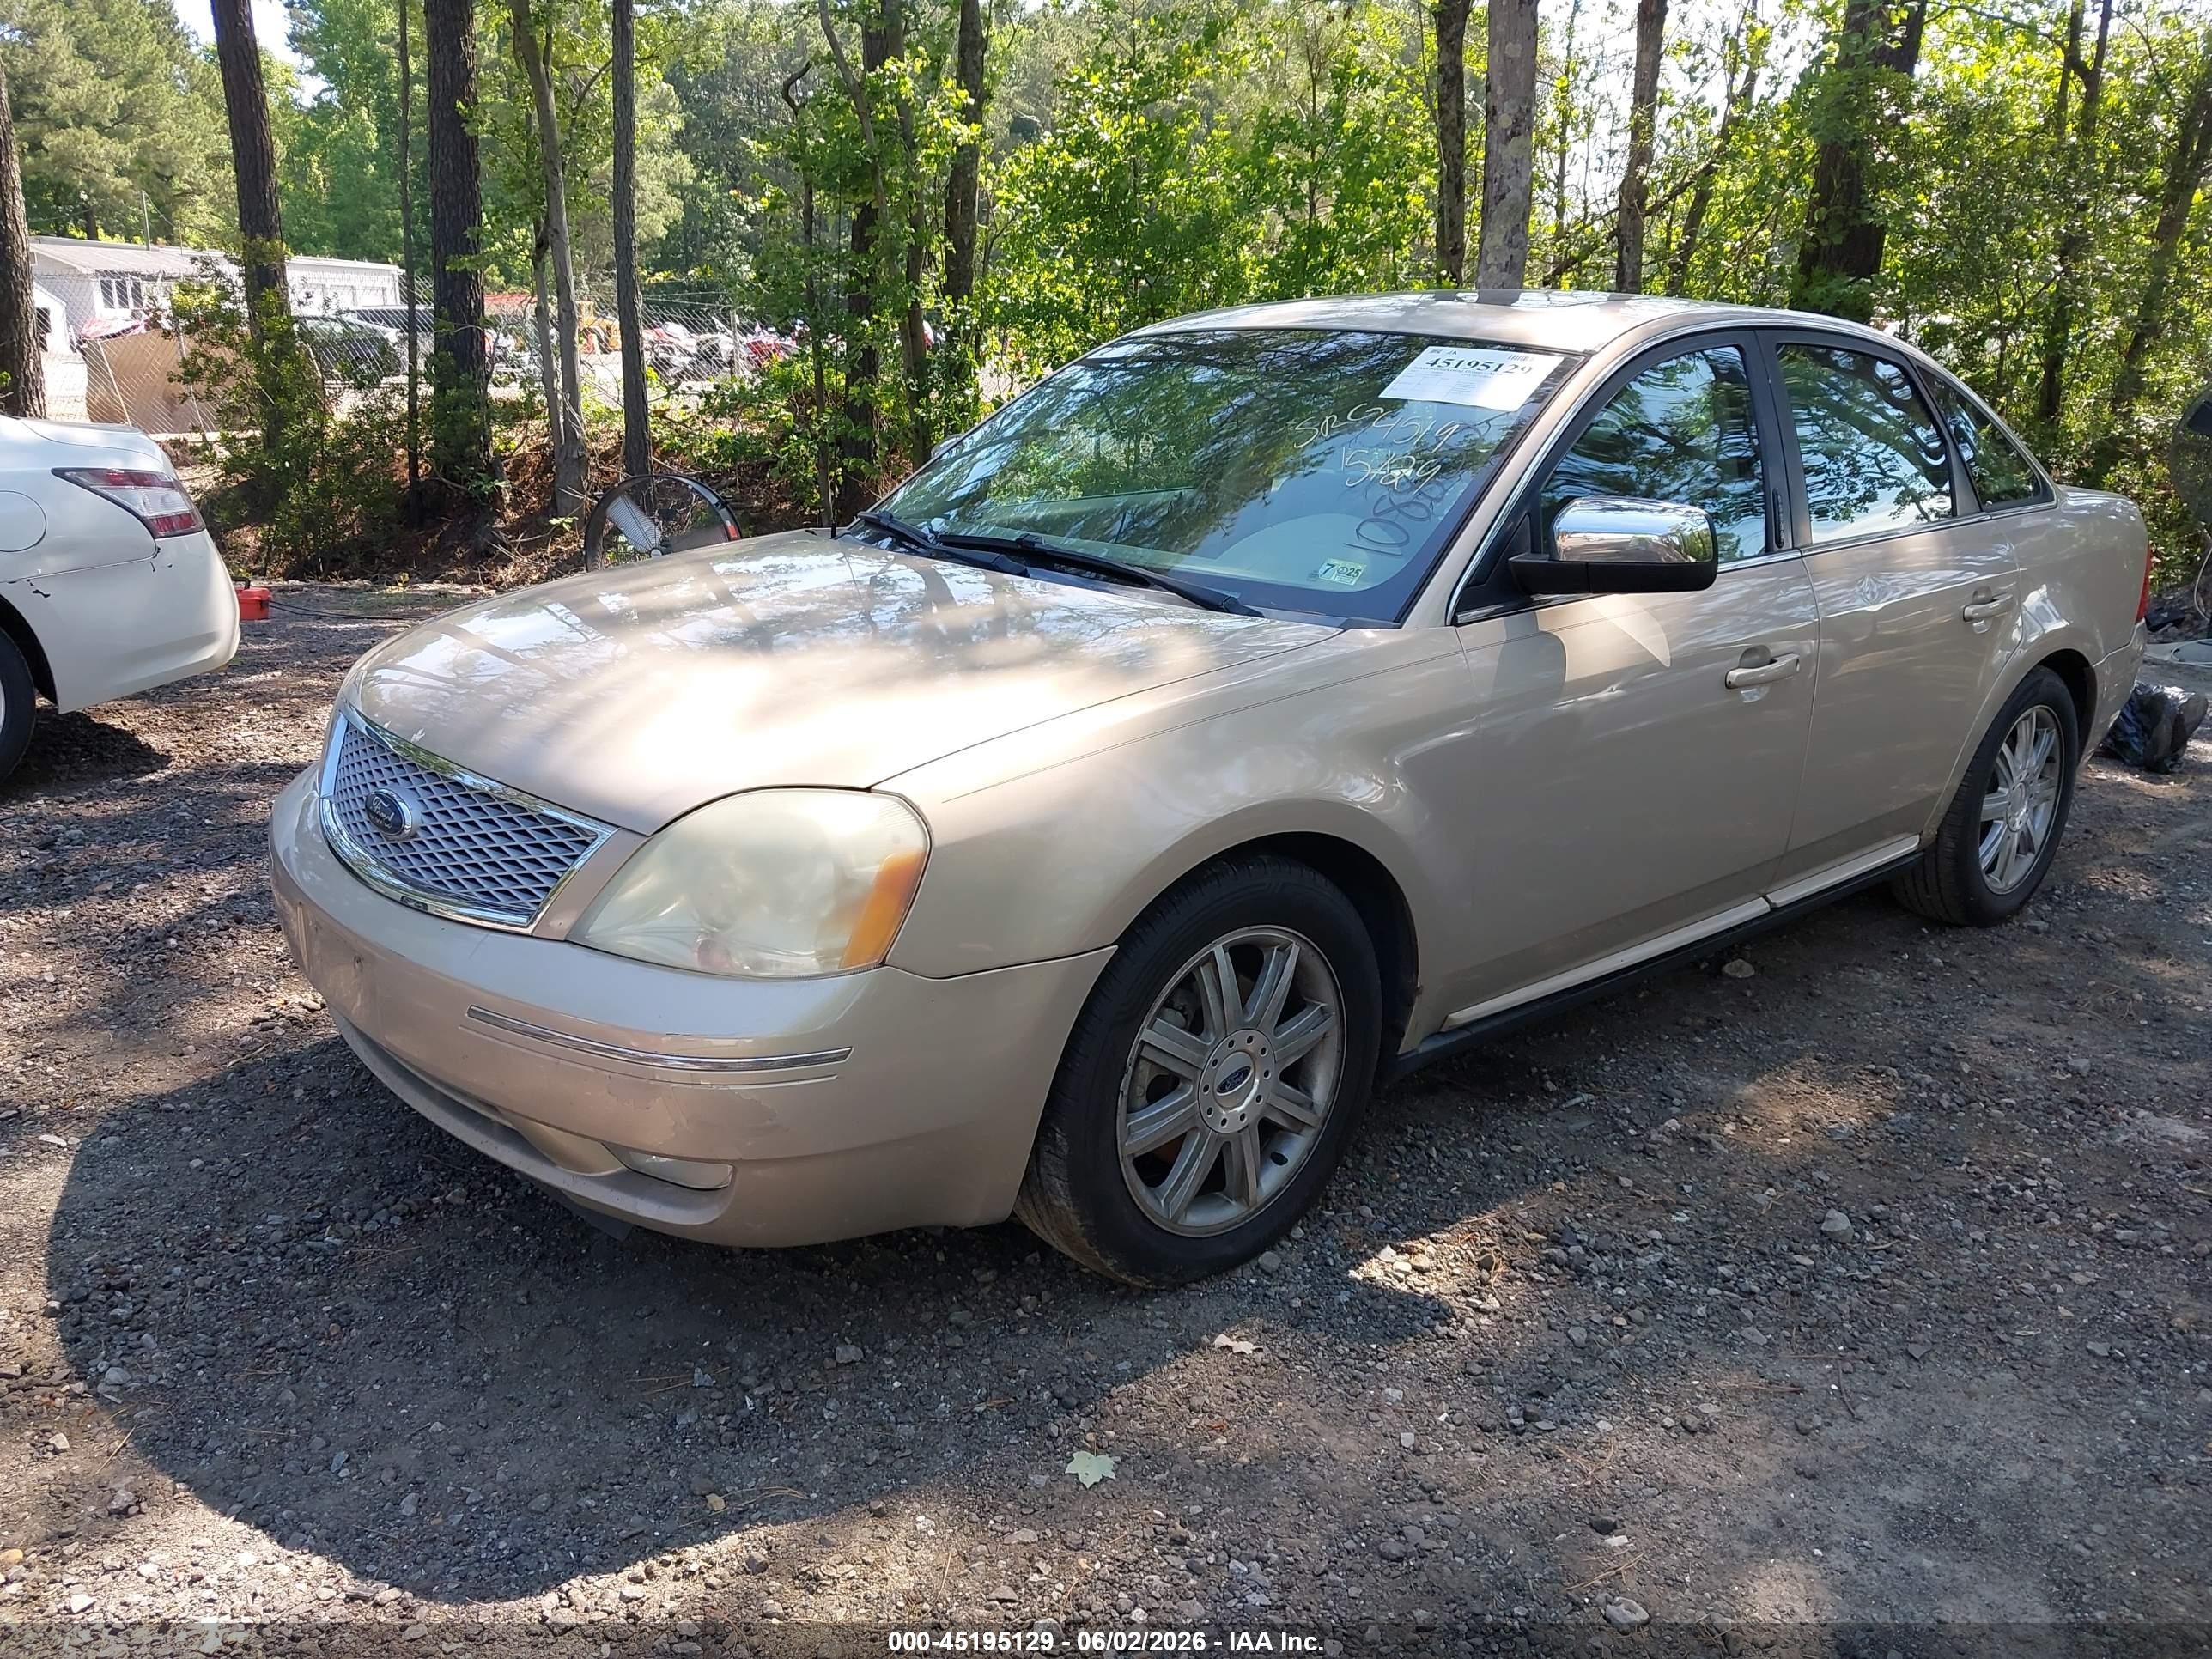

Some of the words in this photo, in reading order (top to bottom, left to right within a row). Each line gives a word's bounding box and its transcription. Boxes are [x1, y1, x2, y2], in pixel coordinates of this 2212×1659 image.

[1425, 357, 1533, 374] 45195129
[1322, 562, 1336, 575] 7
[1346, 568, 1362, 578] 25
